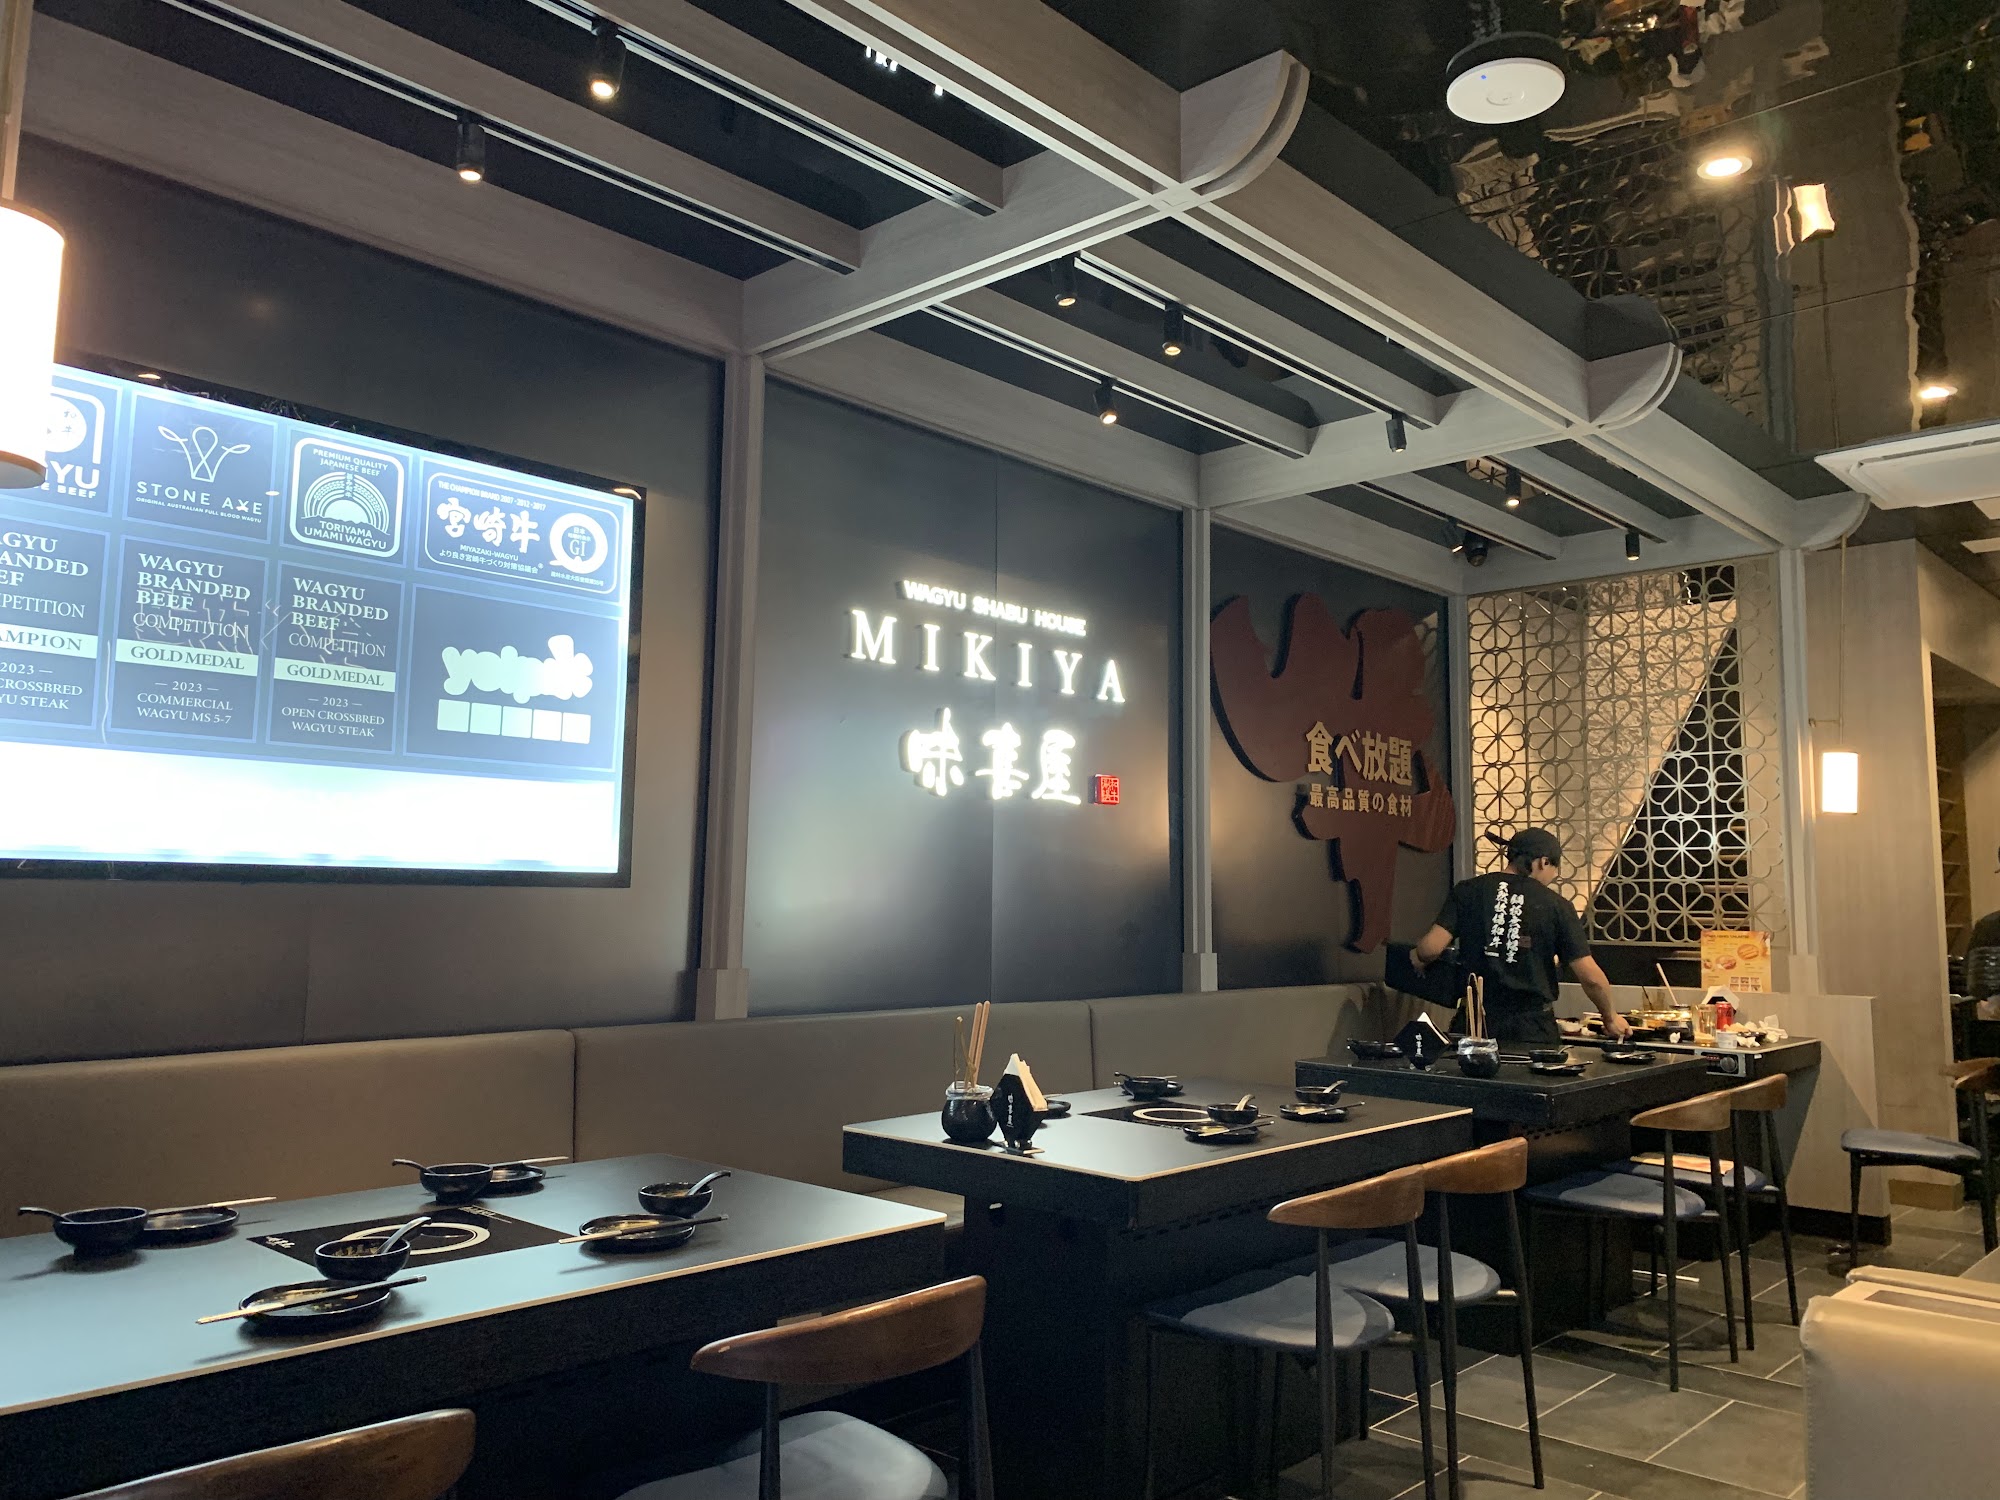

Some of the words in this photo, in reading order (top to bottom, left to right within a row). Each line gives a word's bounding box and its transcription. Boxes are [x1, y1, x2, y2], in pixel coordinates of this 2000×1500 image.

[313, 449, 351, 462] PREMIUM
[353, 457, 389, 471] QUALITY
[320, 458, 359, 473] JAPANESE
[361, 468, 381, 477] BEEF
[45, 460, 100, 490] YU
[57, 484, 97, 499] BEEF
[136, 481, 212, 507] STONE
[222, 496, 264, 517] AXE
[438, 480, 450, 491] THE
[450, 484, 480, 498] CHAMPION
[481, 490, 500, 502] BRAND
[516, 498, 530, 509] 2012
[136, 497, 165, 508] ORIGINAL
[166, 501, 203, 513] AUSTRALIAN
[204, 507, 219, 517] FULL
[220, 511, 240, 520] BLOOD
[241, 515, 262, 523] WAGYU
[320, 520, 373, 538] TORIYAMA
[436, 497, 541, 554] 宮崎牛
[0, 532, 58, 553] GYU
[304, 527, 343, 542] UMAMI
[345, 534, 387, 550] WAGYU
[569, 540, 586, 557] GI
[0, 551, 89, 577] ANDED
[138, 553, 224, 578] WAGYU
[137, 571, 251, 600] BRANDED
[292, 577, 366, 602] WAGYU
[0, 593, 85, 618] PETITION
[136, 590, 194, 610] BEEF
[292, 595, 390, 622] BRANDED
[903, 580, 967, 610] WAGYU
[972, 596, 1028, 624] SHABU
[1034, 608, 1087, 637] HOUSE
[133, 612, 248, 640] COMPETITION
[291, 612, 341, 632] BEEF
[0, 630, 82, 651] MPION
[288, 632, 387, 658] COMPETITION
[131, 645, 183, 663] GOLD
[185, 652, 245, 671] MEDAL
[851, 609, 1126, 703] MIKIYA
[0, 662, 34, 675] 2023
[287, 664, 331, 681] GOLD
[333, 669, 384, 688] MEDAL
[172, 680, 203, 693] 2023
[20, 696, 70, 710] STEAK
[137, 692, 234, 711] COMMERCIAL
[322, 696, 349, 708] 2023
[137, 706, 189, 721] WAGYU
[191, 709, 211, 722] MS
[213, 713, 232, 725] 5-7
[281, 706, 316, 720] OPEN
[317, 710, 385, 726] CROSSBRED
[291, 720, 337, 735] WAGYU
[339, 725, 375, 739] STEAK
[1305, 720, 1413, 787] 食べ放題
[1309, 783, 1413, 818] 最高品質の食材
